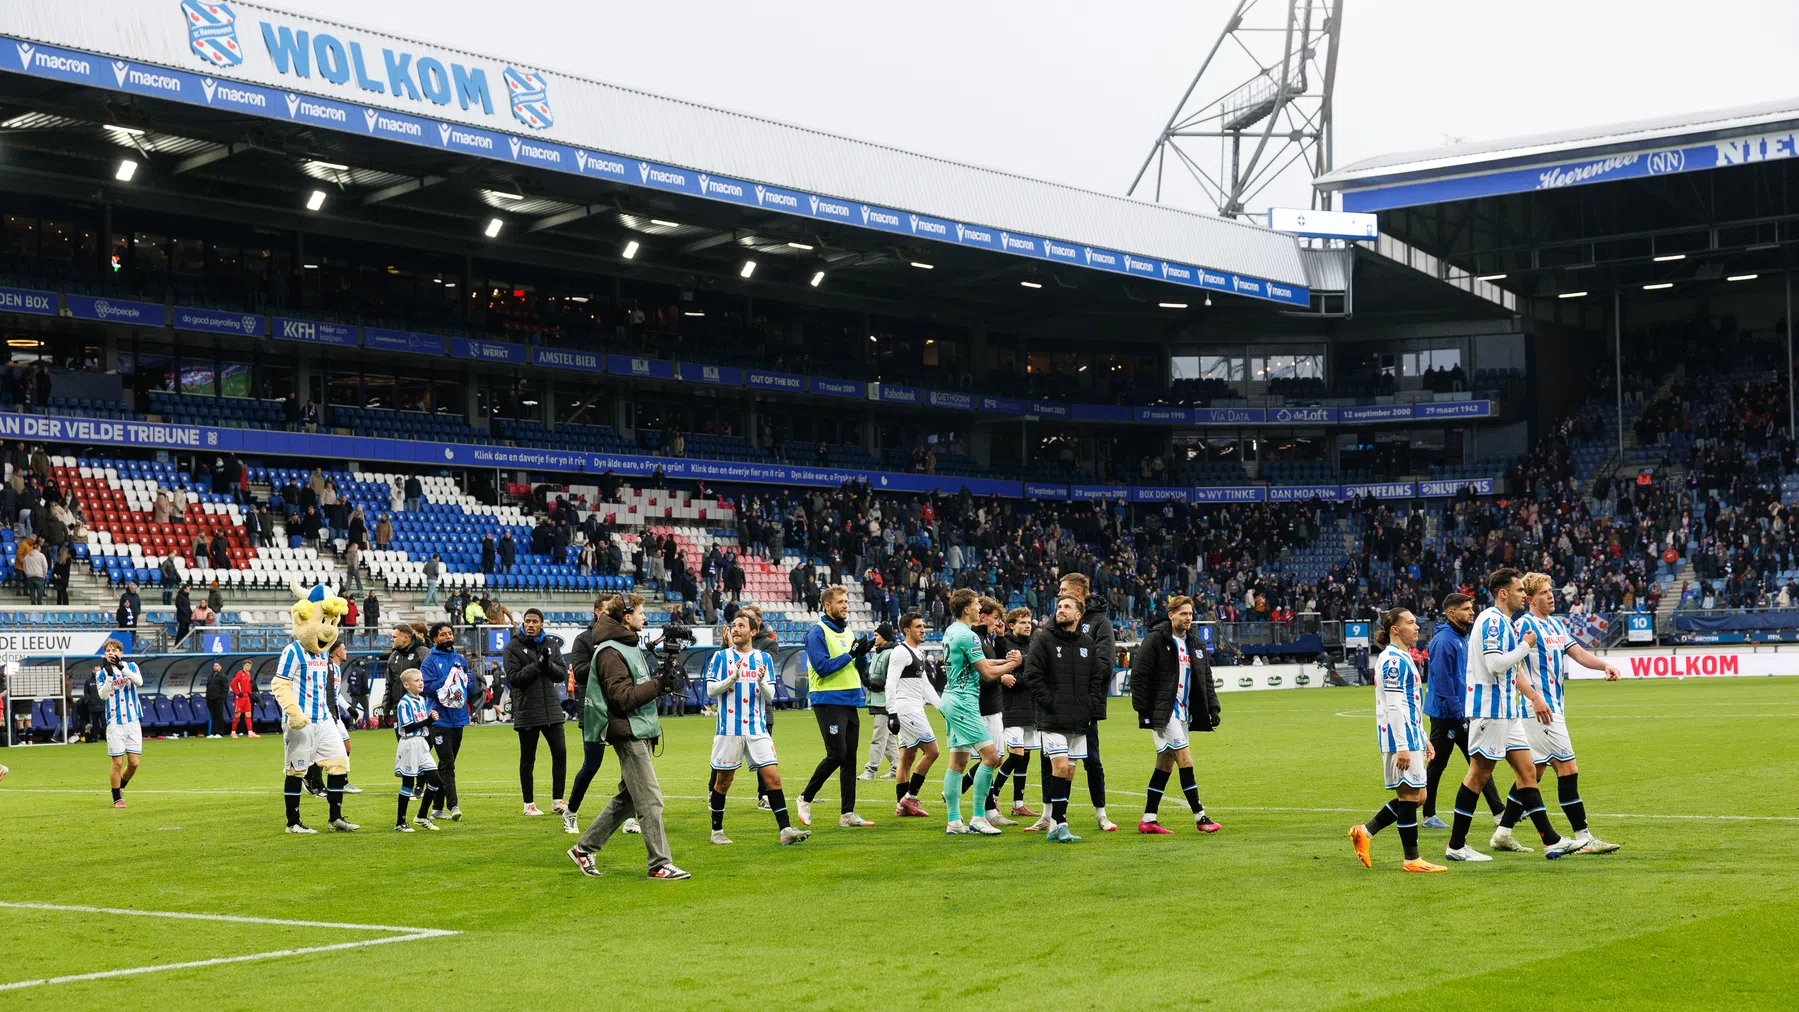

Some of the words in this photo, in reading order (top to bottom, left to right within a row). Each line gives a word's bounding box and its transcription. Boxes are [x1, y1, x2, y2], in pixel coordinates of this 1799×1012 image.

[36, 53, 89, 75] macron
[259, 21, 495, 115] WOLKOM
[130, 71, 180, 91] macron
[217, 86, 266, 107] macron
[301, 103, 346, 122] macron
[379, 116, 421, 136] macron
[452, 133, 493, 150] macron
[522, 145, 560, 163] macron
[588, 157, 624, 174] macron
[1653, 151, 1679, 172] NN
[650, 169, 685, 186] macron
[709, 181, 743, 197] macron
[765, 192, 797, 207] macron
[819, 202, 849, 216] macron
[870, 211, 899, 226] macron
[918, 220, 946, 235] macron
[964, 228, 991, 243] macron
[1009, 238, 1035, 251] macron
[1051, 245, 1076, 258] macron
[1091, 252, 1116, 265] macron
[1130, 259, 1154, 272] macron
[1168, 266, 1190, 279] macron
[1204, 274, 1225, 285] macron
[1239, 280, 1259, 292] macron
[1272, 287, 1292, 298] macron
[25, 296, 49, 309] BOX
[182, 314, 191, 322] do
[192, 317, 209, 325] good
[483, 348, 508, 358] WERKT
[540, 351, 574, 365] AMSTEL
[576, 354, 597, 367] BIER
[751, 375, 764, 383] OUT
[774, 378, 787, 386] THE
[787, 379, 800, 387] BOX
[884, 388, 915, 401] Rabobank
[1293, 410, 1328, 421] deLoft
[1354, 409, 1390, 419] septimber
[1392, 408, 1411, 416] 2000
[1437, 406, 1459, 414] maart
[1461, 404, 1479, 412] 1942
[24, 418, 61, 438] DER
[65, 421, 124, 441] VELDE
[127, 425, 199, 445] TRIBUNE
[474, 450, 493, 460] Klink
[494, 452, 507, 462] dan
[519, 454, 545, 465] daverje
[568, 457, 573, 465] it
[594, 458, 606, 468] Dyn
[623, 461, 639, 470] eare,
[646, 462, 666, 472] Frye
[691, 464, 707, 473] Klink
[708, 465, 719, 474] dan
[728, 467, 750, 477] daverje
[751, 468, 761, 476] fier
[762, 470, 769, 478] yn
[791, 470, 801, 479] Dyn
[1113, 490, 1127, 498] 2007
[1139, 490, 1154, 498] BOX
[1156, 490, 1187, 498] DOKKUM
[1207, 490, 1222, 499] WY
[1225, 489, 1255, 498] TINKE
[1271, 489, 1291, 499] OAN
[1294, 489, 1329, 498] MOARN
[1422, 481, 1489, 494] ONLYFNS
[1632, 617, 1648, 629] 10
[1204, 628, 1209, 640] 8
[1352, 625, 1361, 636] 9
[0, 636, 17, 650] DE
[22, 636, 71, 650] LEEUW
[212, 636, 223, 653] 4
[496, 632, 504, 650] 5
[0, 654, 25, 662] ODEN
[1630, 655, 1738, 676] WOLKOM
[728, 670, 757, 678] WLKO
